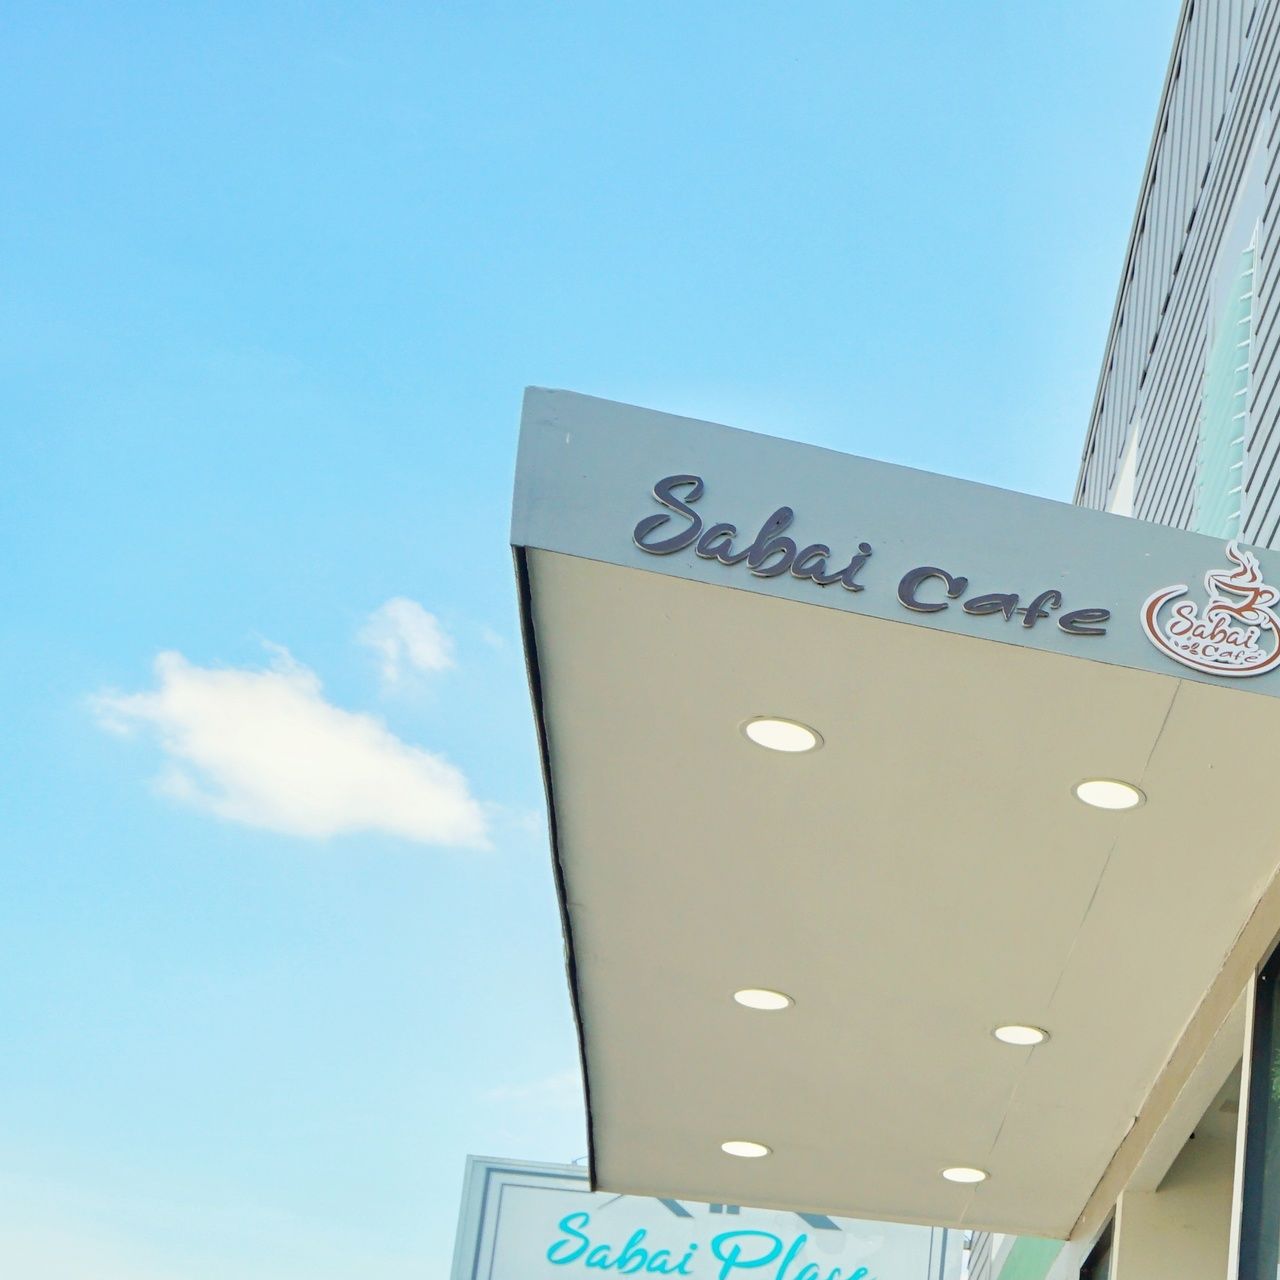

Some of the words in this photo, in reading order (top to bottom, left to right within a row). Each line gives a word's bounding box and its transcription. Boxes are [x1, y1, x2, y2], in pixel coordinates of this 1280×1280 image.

[632, 473, 873, 593] Sabai
[1170, 605, 1255, 649] Sabai
[545, 1211, 700, 1276] Sabai
